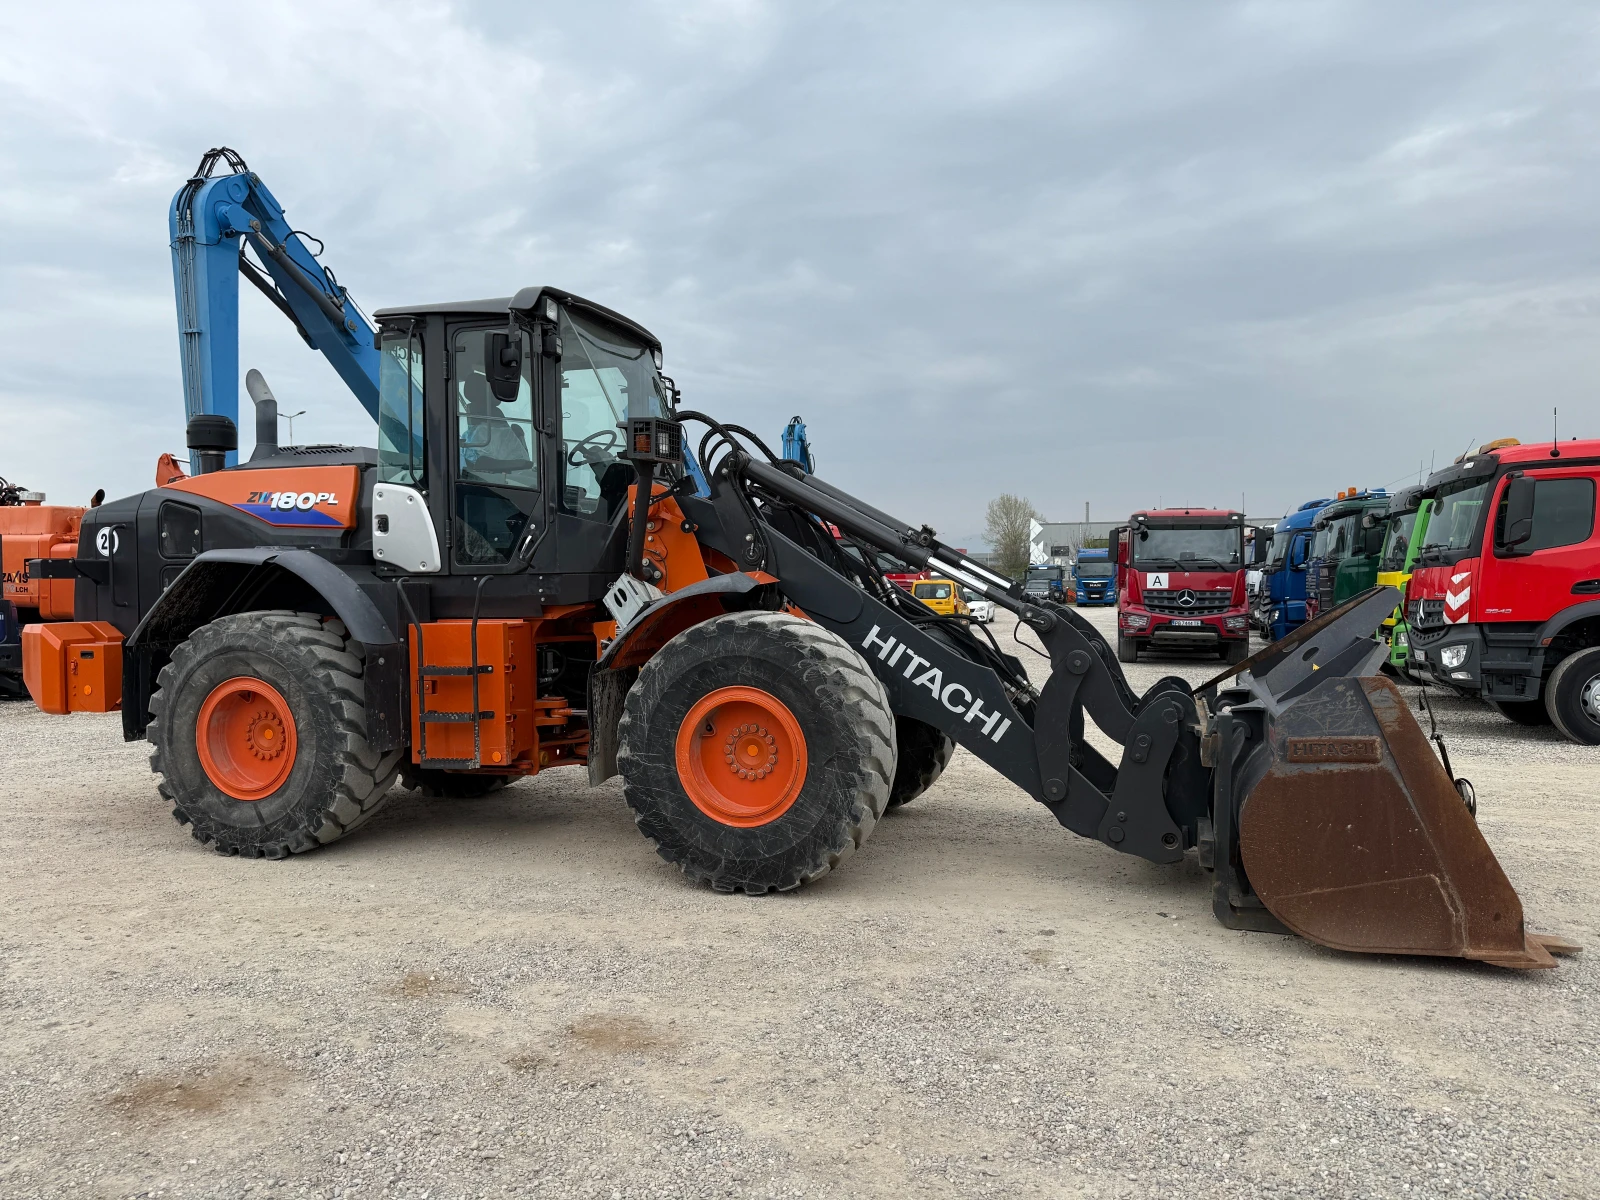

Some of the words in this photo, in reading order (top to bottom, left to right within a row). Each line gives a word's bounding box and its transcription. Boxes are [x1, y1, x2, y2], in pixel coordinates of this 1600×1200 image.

[1152, 575, 1163, 587] A
[861, 624, 1012, 744] HITACHI
[1293, 742, 1376, 757] HITACHI
